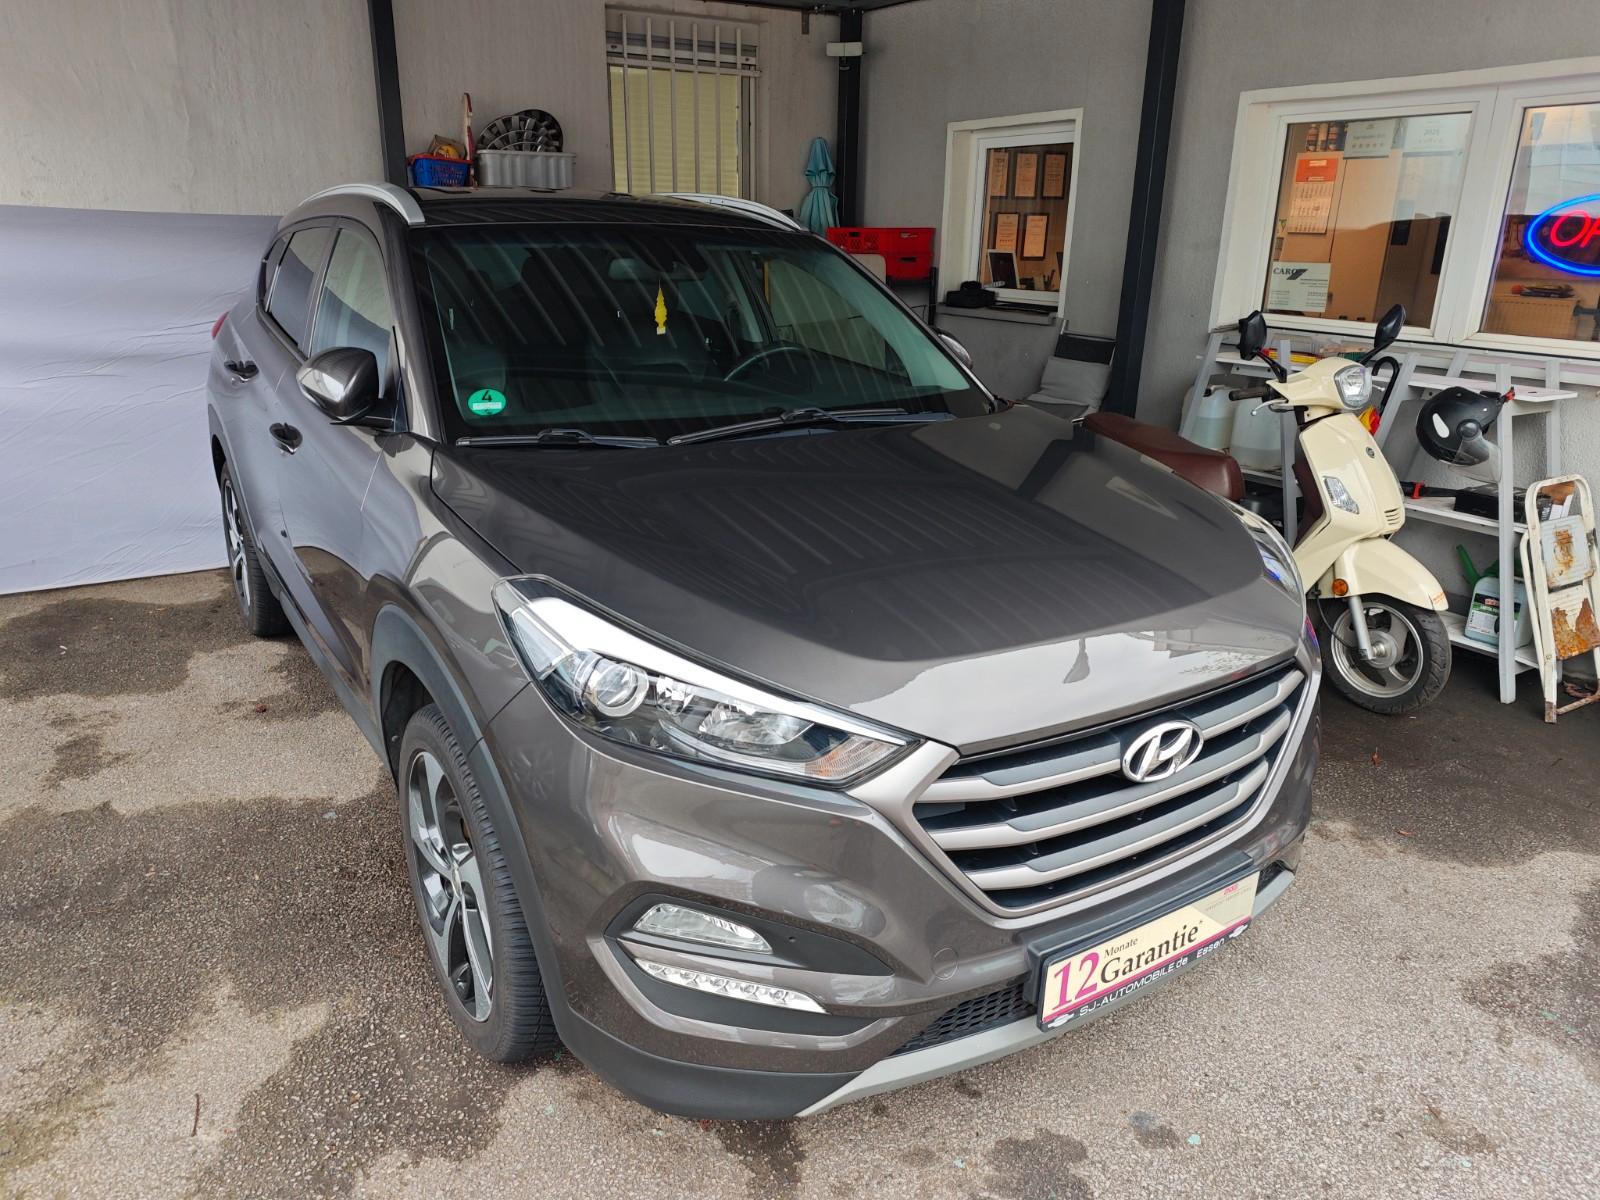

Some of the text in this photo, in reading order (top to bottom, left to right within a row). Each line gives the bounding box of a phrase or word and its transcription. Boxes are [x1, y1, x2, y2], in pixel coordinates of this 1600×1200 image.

[482, 390, 492, 402] 4
[1104, 938, 1138, 958] Monate
[1052, 952, 1100, 1011] 12
